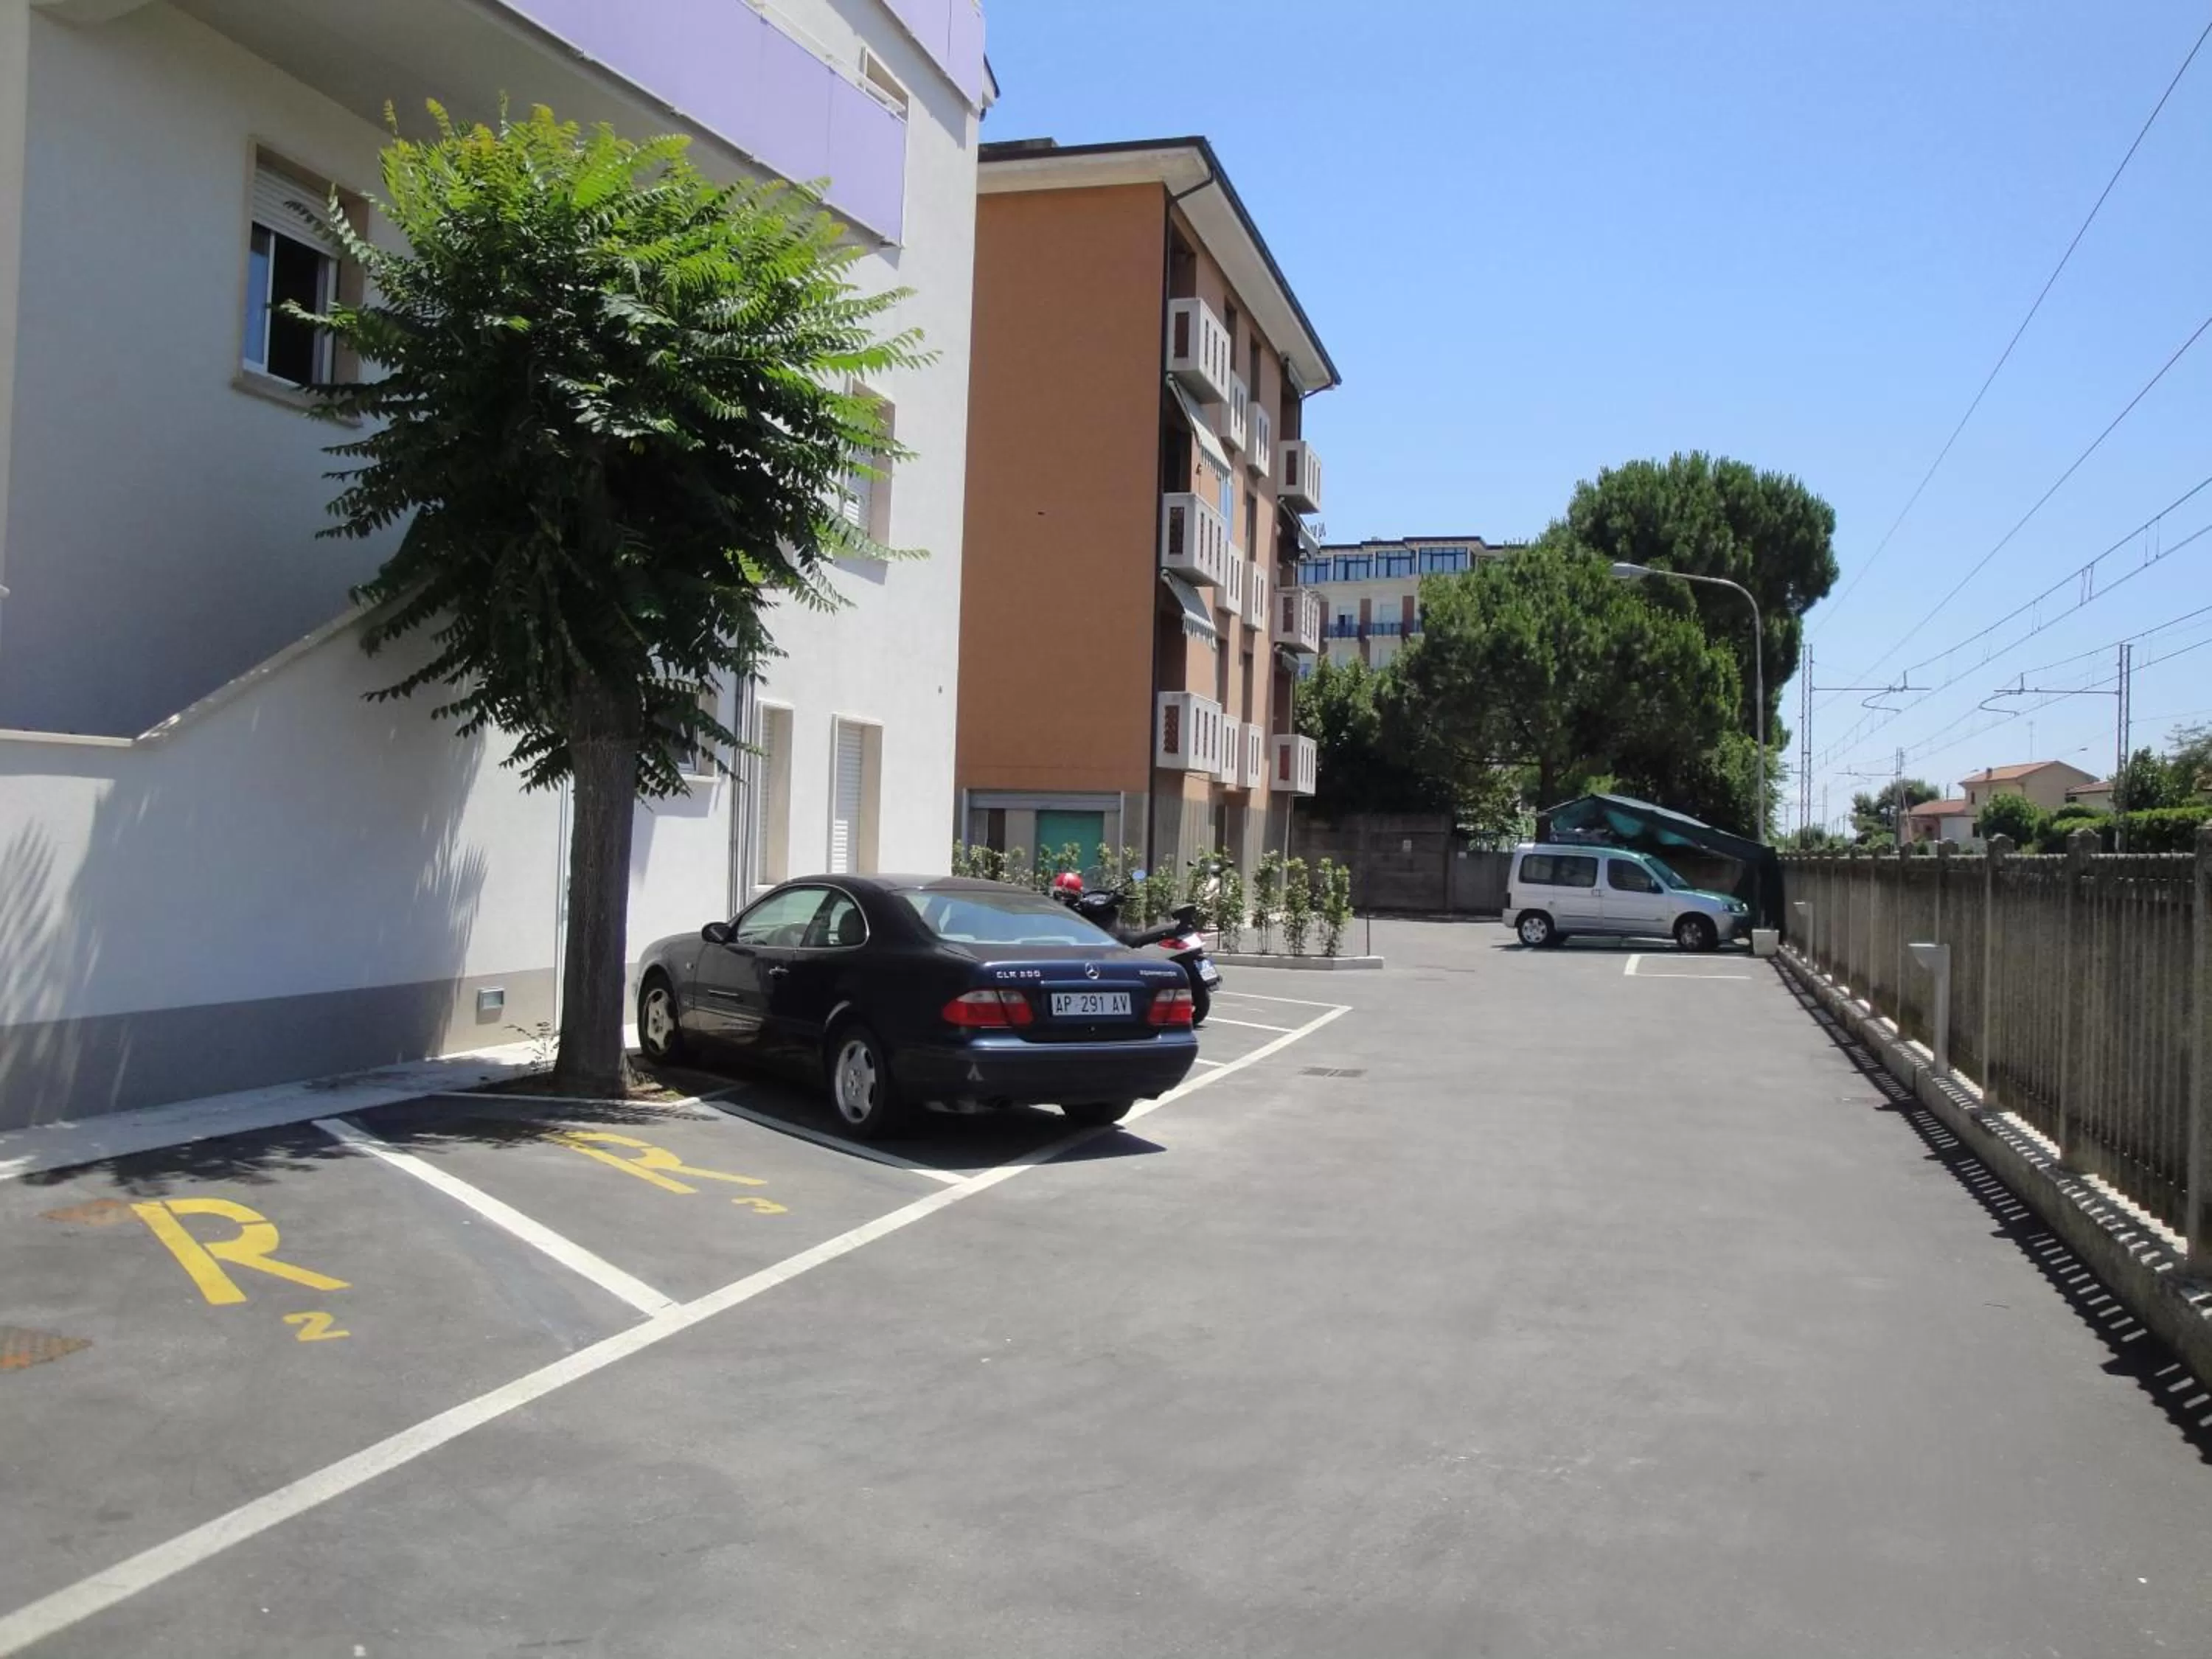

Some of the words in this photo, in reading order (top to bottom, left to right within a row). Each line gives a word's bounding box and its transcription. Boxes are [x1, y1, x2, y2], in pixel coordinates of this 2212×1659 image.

[1056, 995, 1071, 1012] AP
[1081, 995, 1104, 1012] 291
[1113, 995, 1127, 1012] AV
[130, 1198, 352, 1305] R
[282, 1312, 351, 1342] 2
